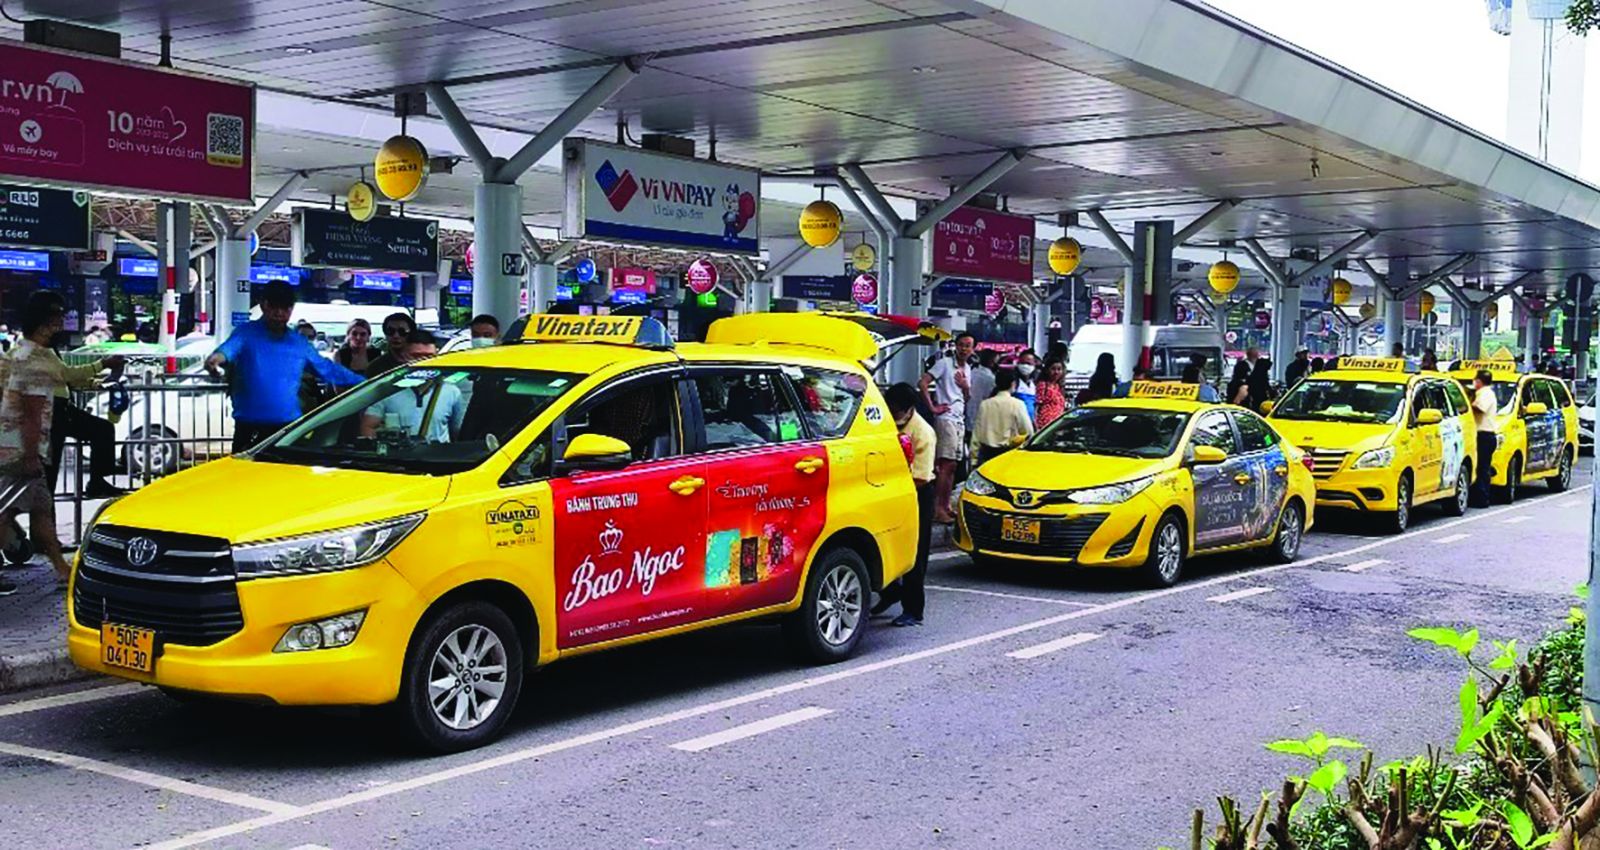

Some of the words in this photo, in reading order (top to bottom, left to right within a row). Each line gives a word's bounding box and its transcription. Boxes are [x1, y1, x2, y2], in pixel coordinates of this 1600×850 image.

[107, 110, 134, 134] 10
[136, 115, 165, 129] năm
[40, 150, 58, 160] bay
[108, 138, 134, 152] Dịch
[136, 144, 150, 155] vụ
[661, 180, 716, 208] VNPAY
[534, 316, 633, 337] Vinataxi
[1341, 358, 1399, 370] Vinataxi
[1464, 361, 1512, 371] Vinataxi
[1133, 383, 1196, 396] Vinataxi
[566, 495, 591, 513] BÁNH
[592, 494, 621, 510] TRUNG
[621, 492, 638, 507] THU
[490, 508, 537, 521] VINATAXI
[116, 628, 140, 648] 50E
[106, 646, 147, 669] 041.30
